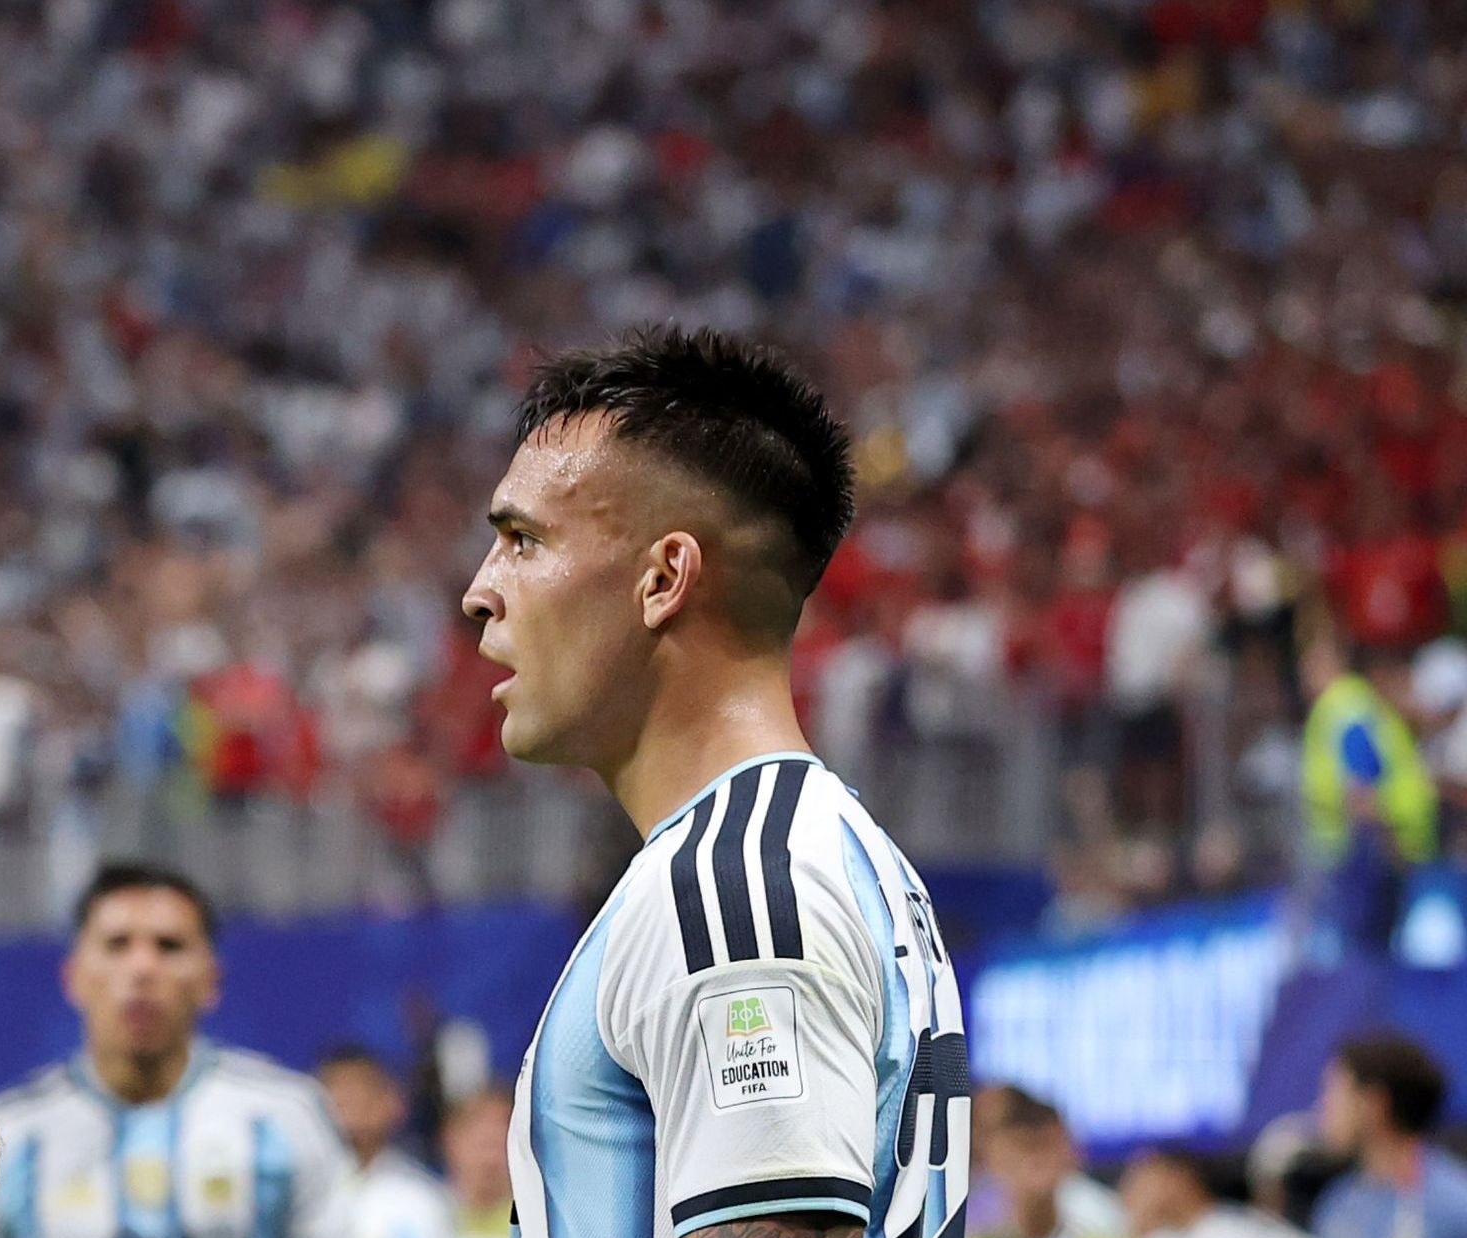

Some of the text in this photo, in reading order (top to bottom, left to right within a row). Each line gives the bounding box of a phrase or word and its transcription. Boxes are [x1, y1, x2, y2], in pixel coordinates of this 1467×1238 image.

[726, 1037, 776, 1063] Unite For
[721, 1061, 789, 1085] EDUCATION
[741, 1083, 767, 1095] FIFA
